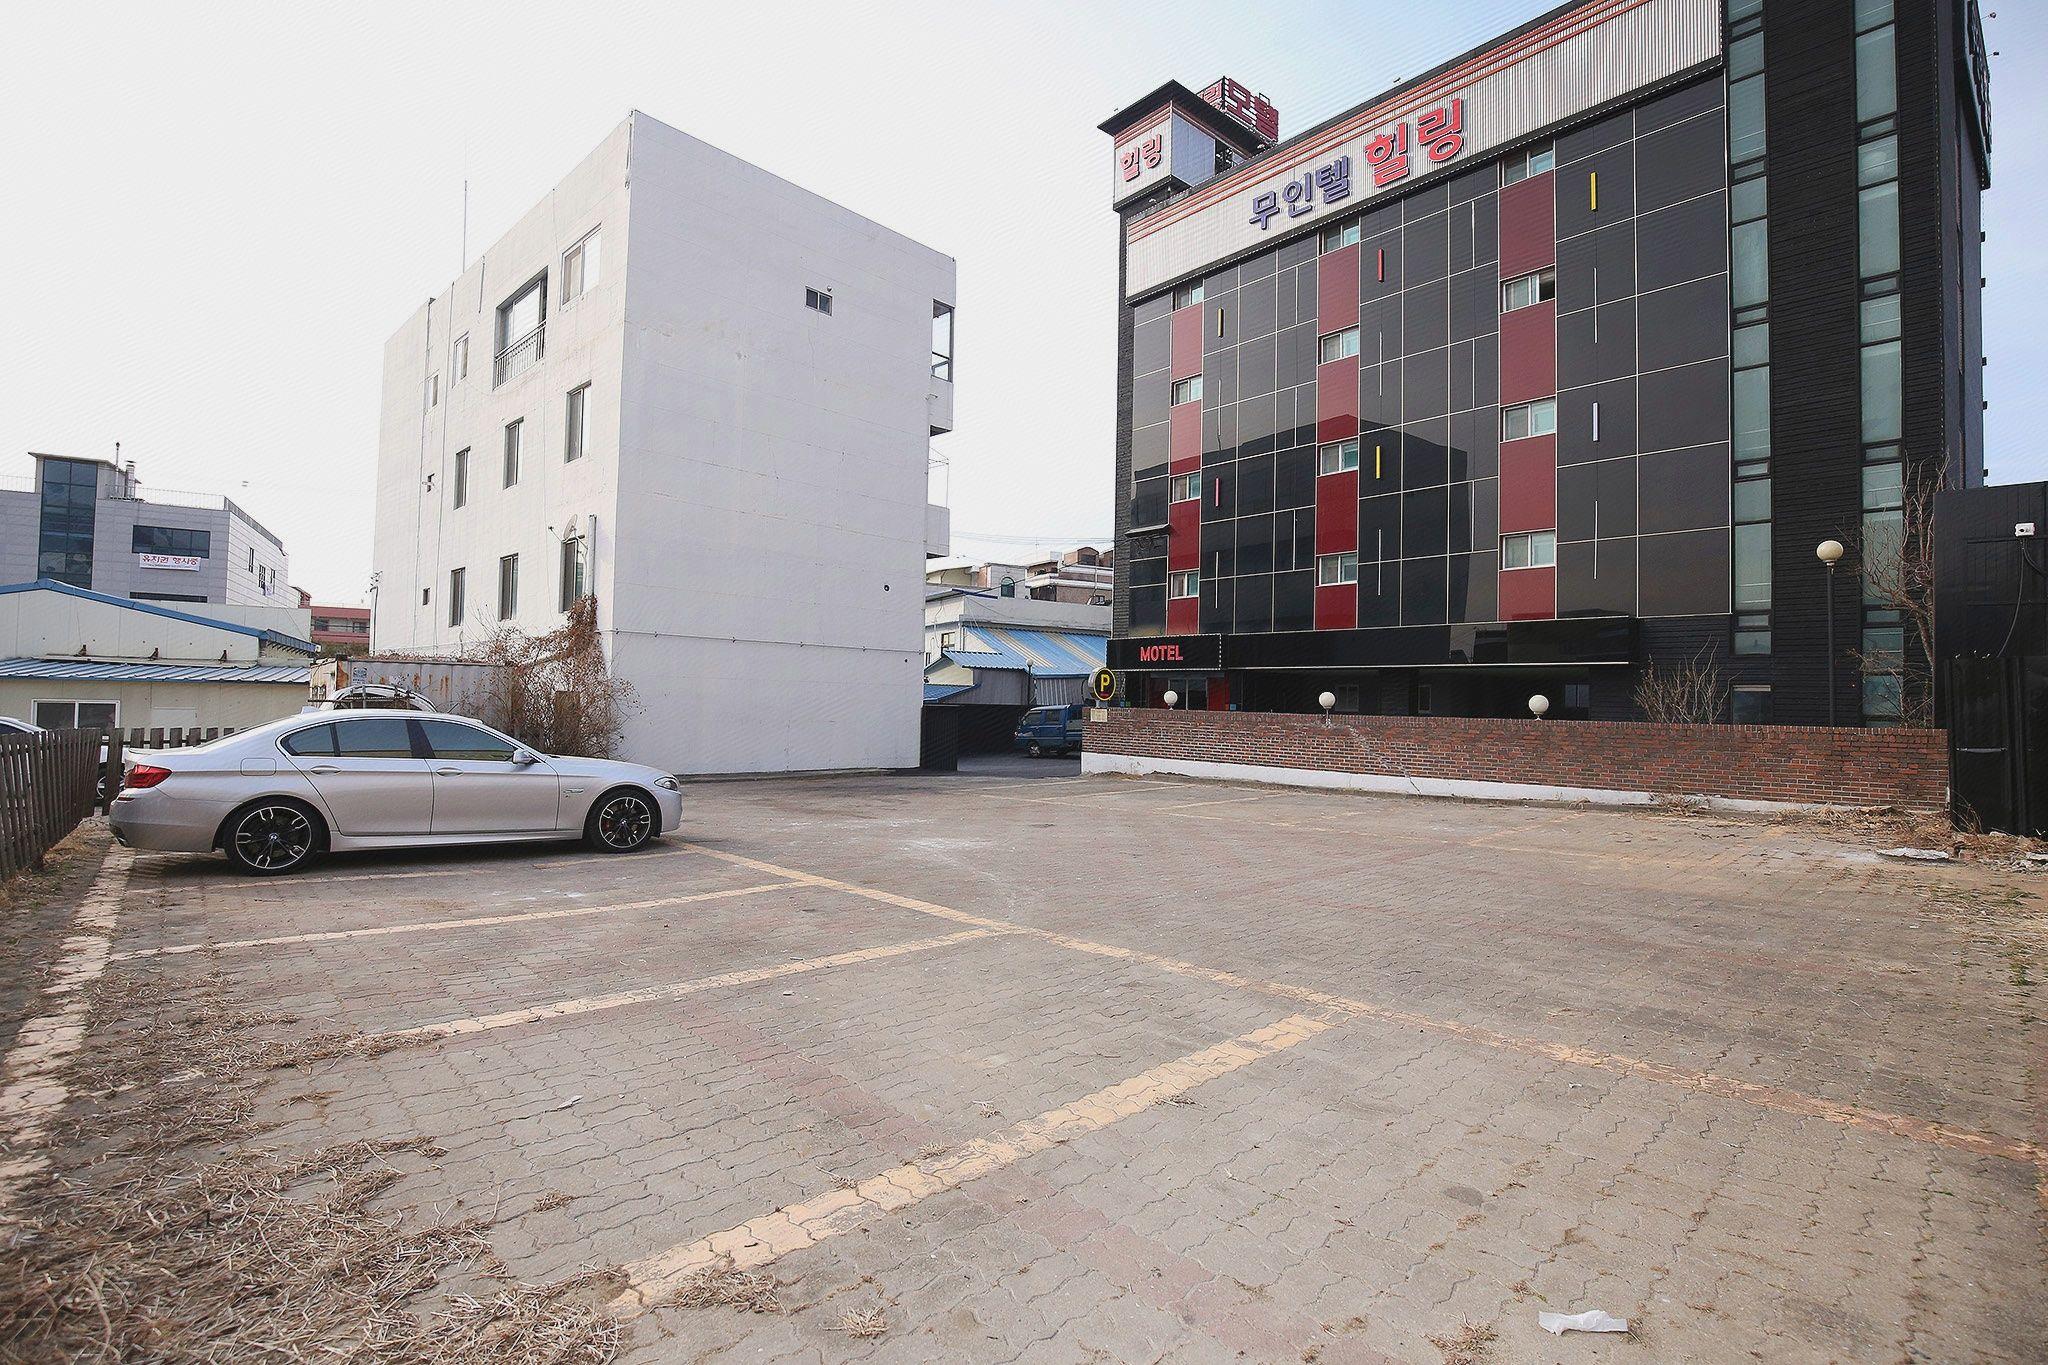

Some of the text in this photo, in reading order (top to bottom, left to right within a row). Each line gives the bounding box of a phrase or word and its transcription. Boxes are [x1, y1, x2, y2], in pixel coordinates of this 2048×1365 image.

[1119, 133, 1162, 182] 힐링
[1249, 99, 1467, 230] 무인텔 힐링
[1140, 645, 1184, 662] MOTEL
[1100, 674, 1110, 692] P
